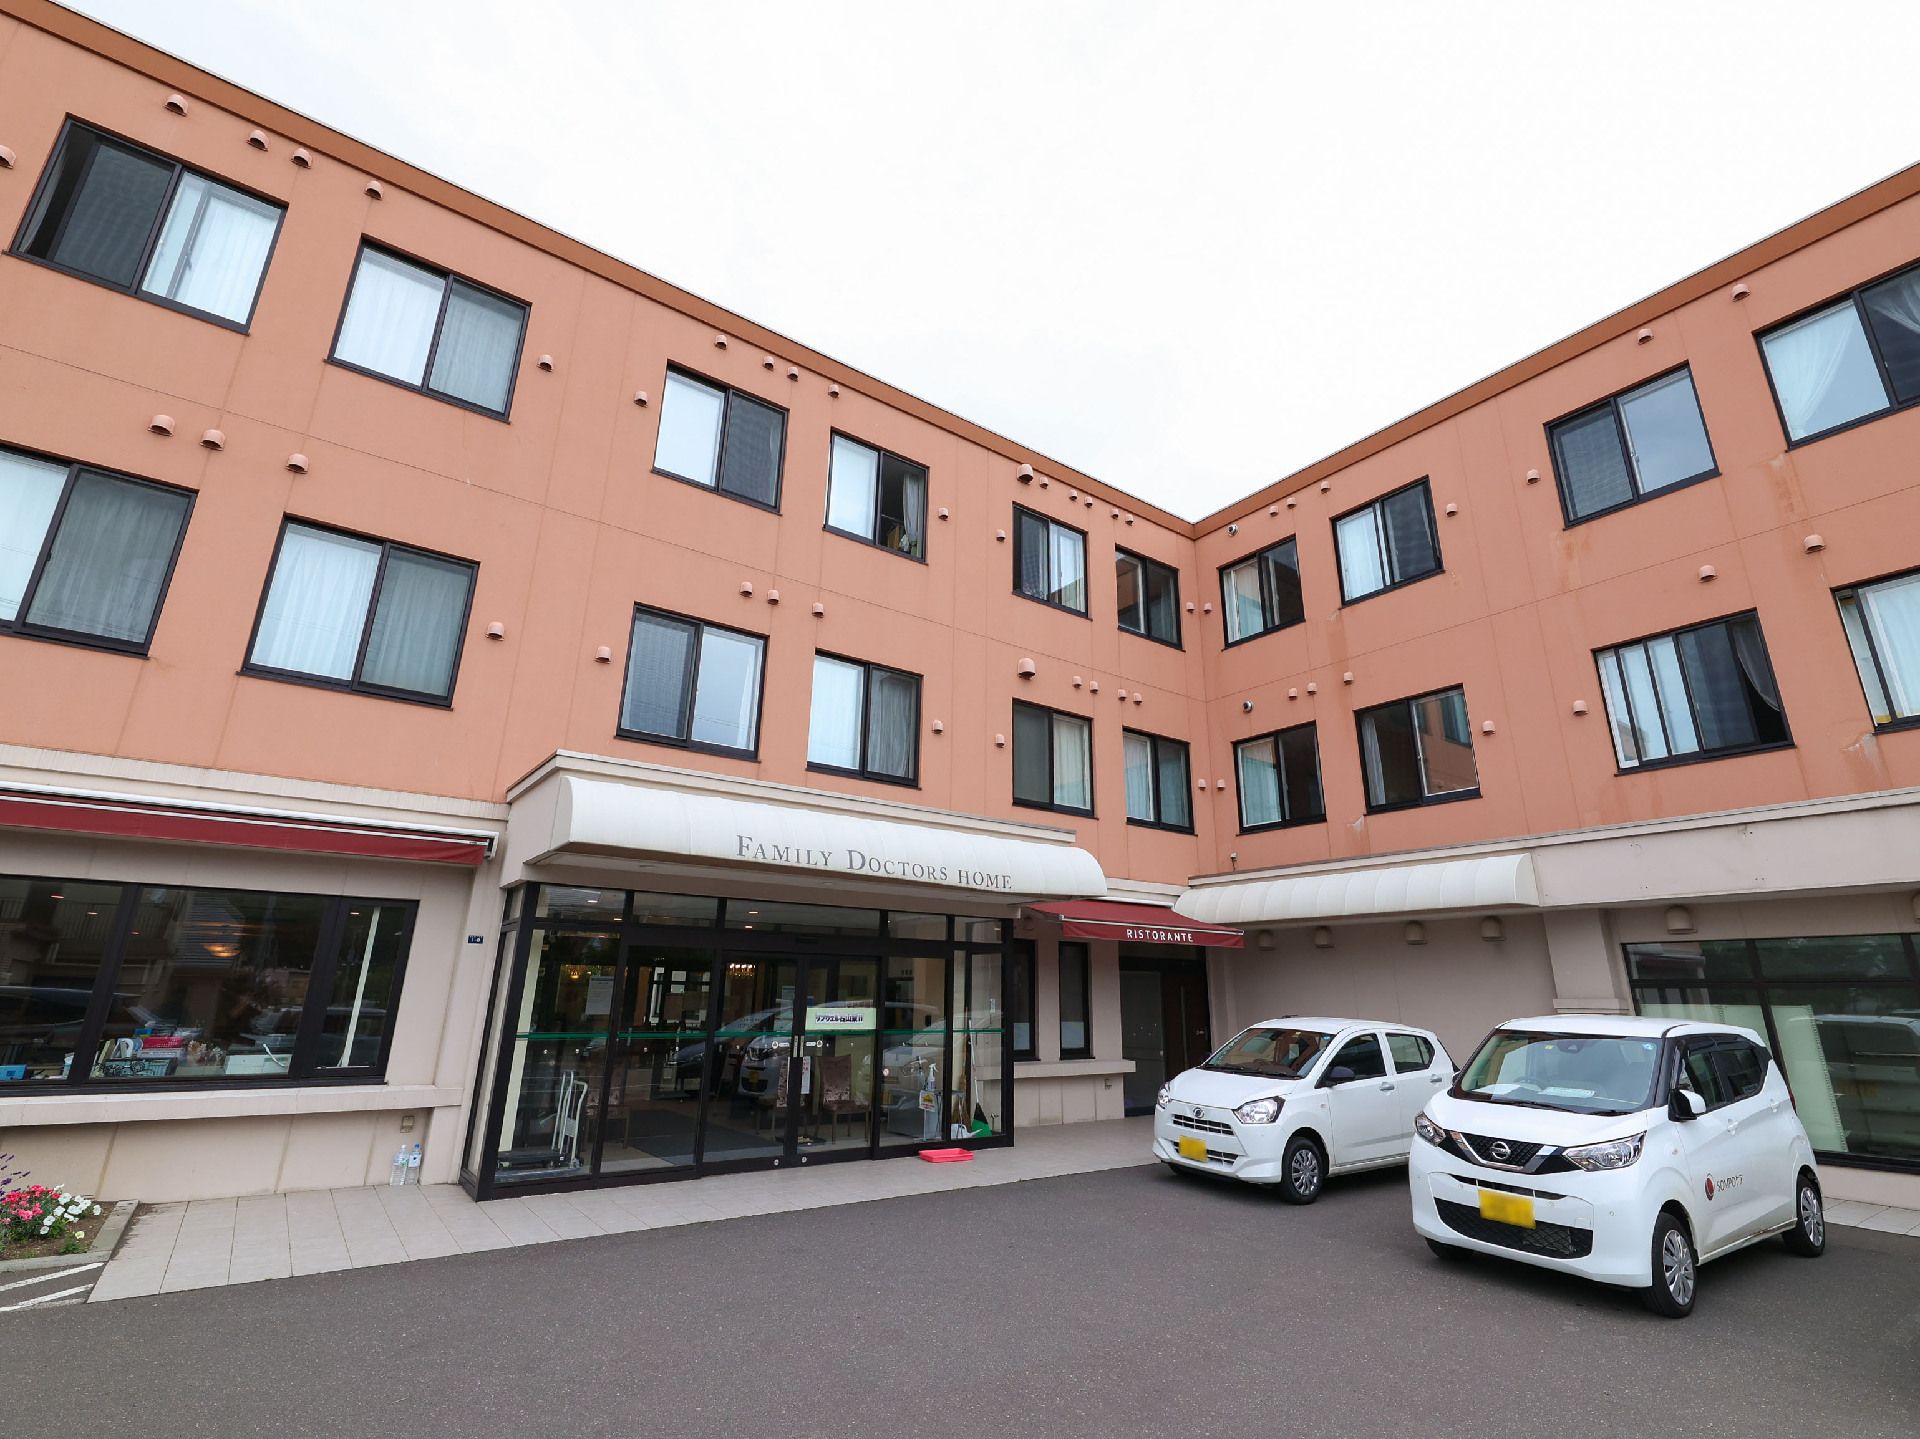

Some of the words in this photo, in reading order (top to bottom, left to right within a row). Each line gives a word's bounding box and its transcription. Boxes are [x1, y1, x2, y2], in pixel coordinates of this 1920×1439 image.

[736, 834, 833, 867] FAMILY
[847, 849, 948, 881] DOCTORS
[957, 869, 1012, 889] HOME
[1126, 928, 1194, 942] RISTORANTE
